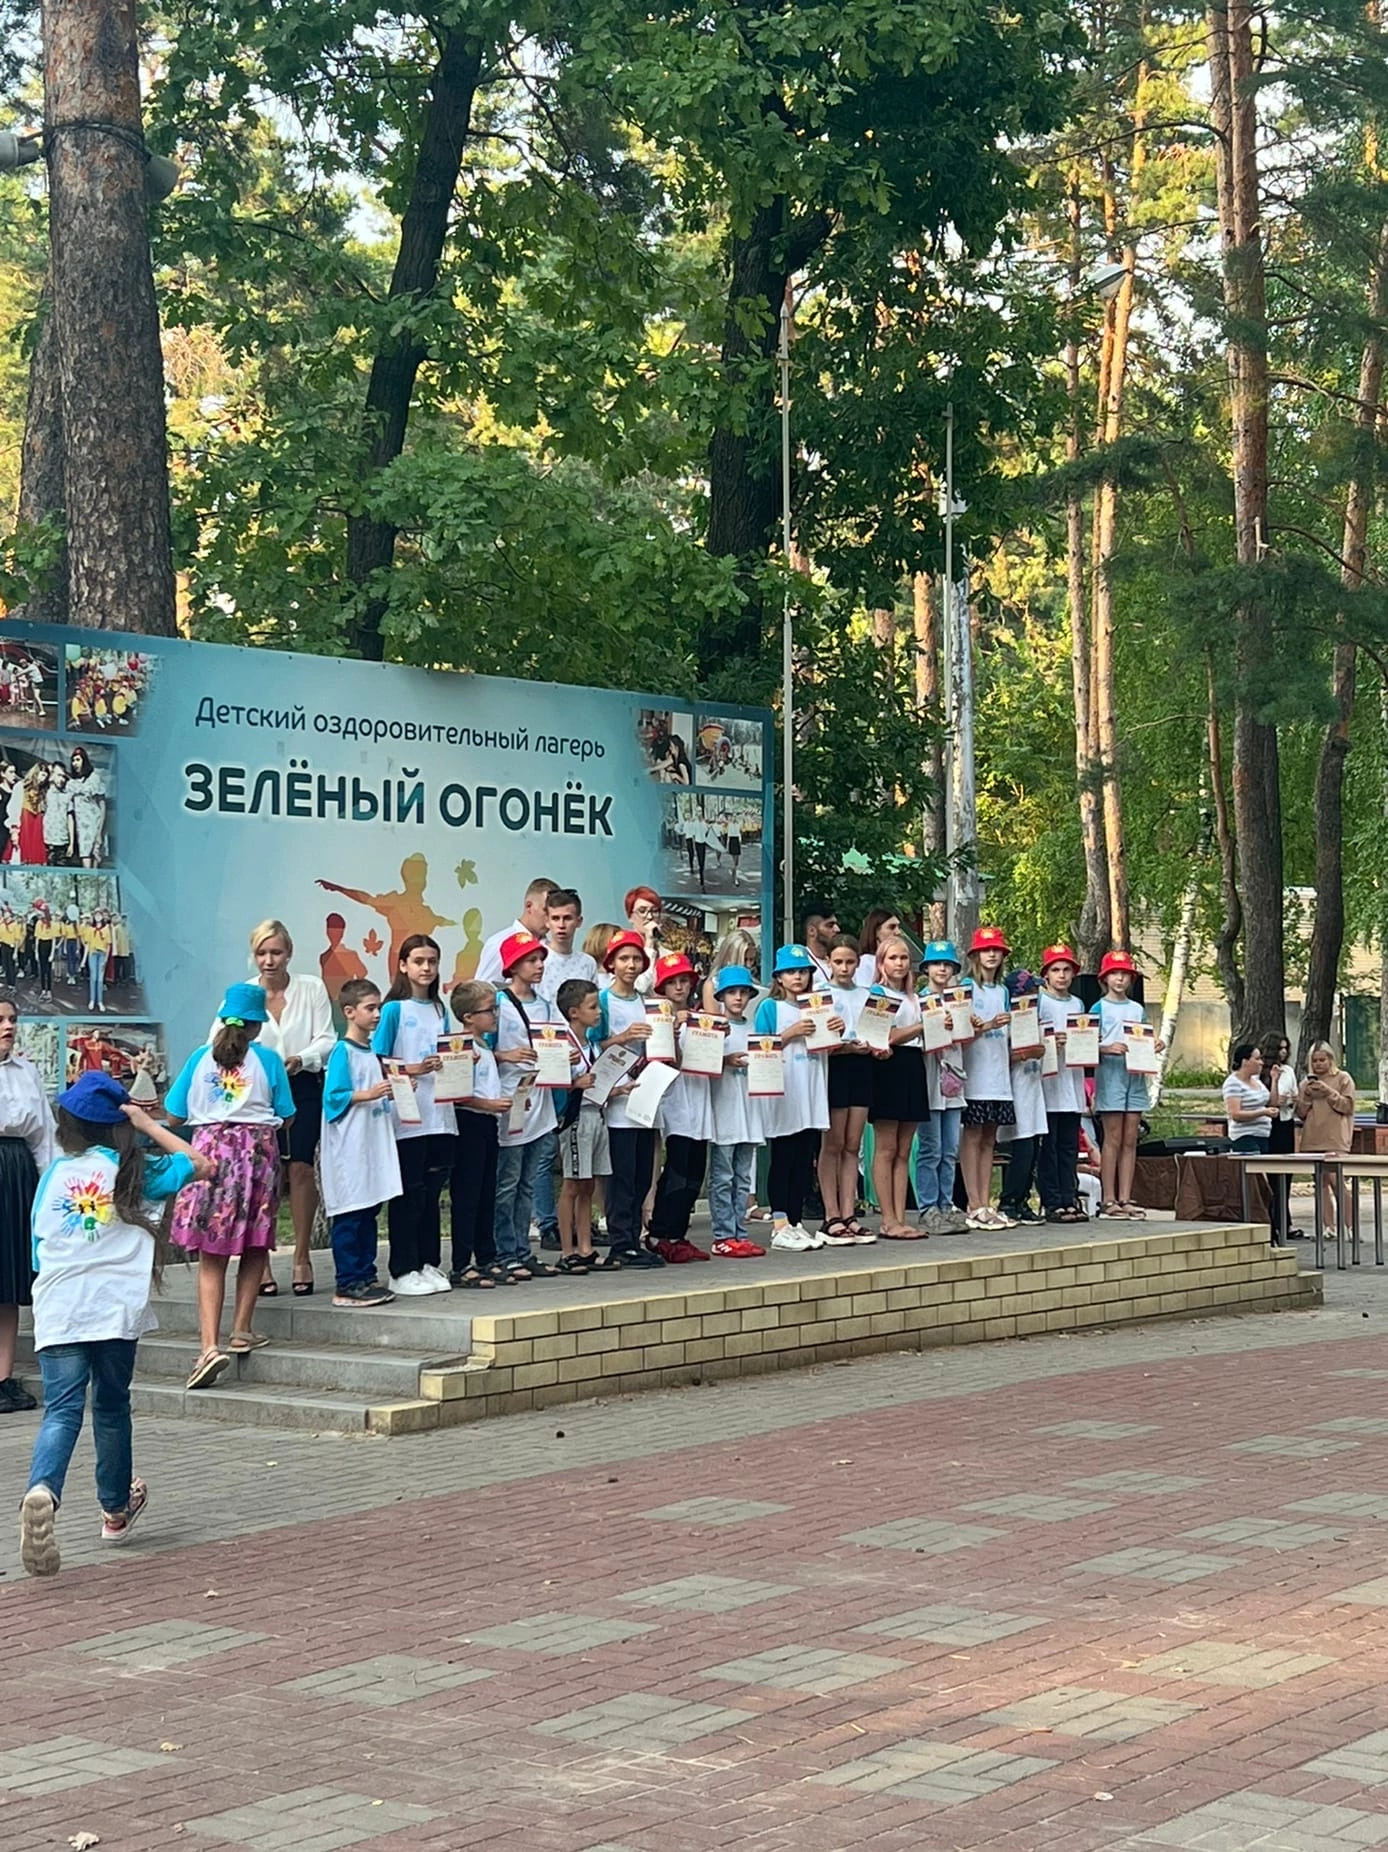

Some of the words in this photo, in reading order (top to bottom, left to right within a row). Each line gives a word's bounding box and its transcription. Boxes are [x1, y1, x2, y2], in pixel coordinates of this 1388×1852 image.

[195, 697, 306, 731] Детский
[313, 713, 529, 752] оздоровительный
[535, 735, 606, 762] лагерь
[184, 759, 425, 824] ЗЕЛЁНЫЙ
[440, 781, 614, 836] ОГОНЁК
